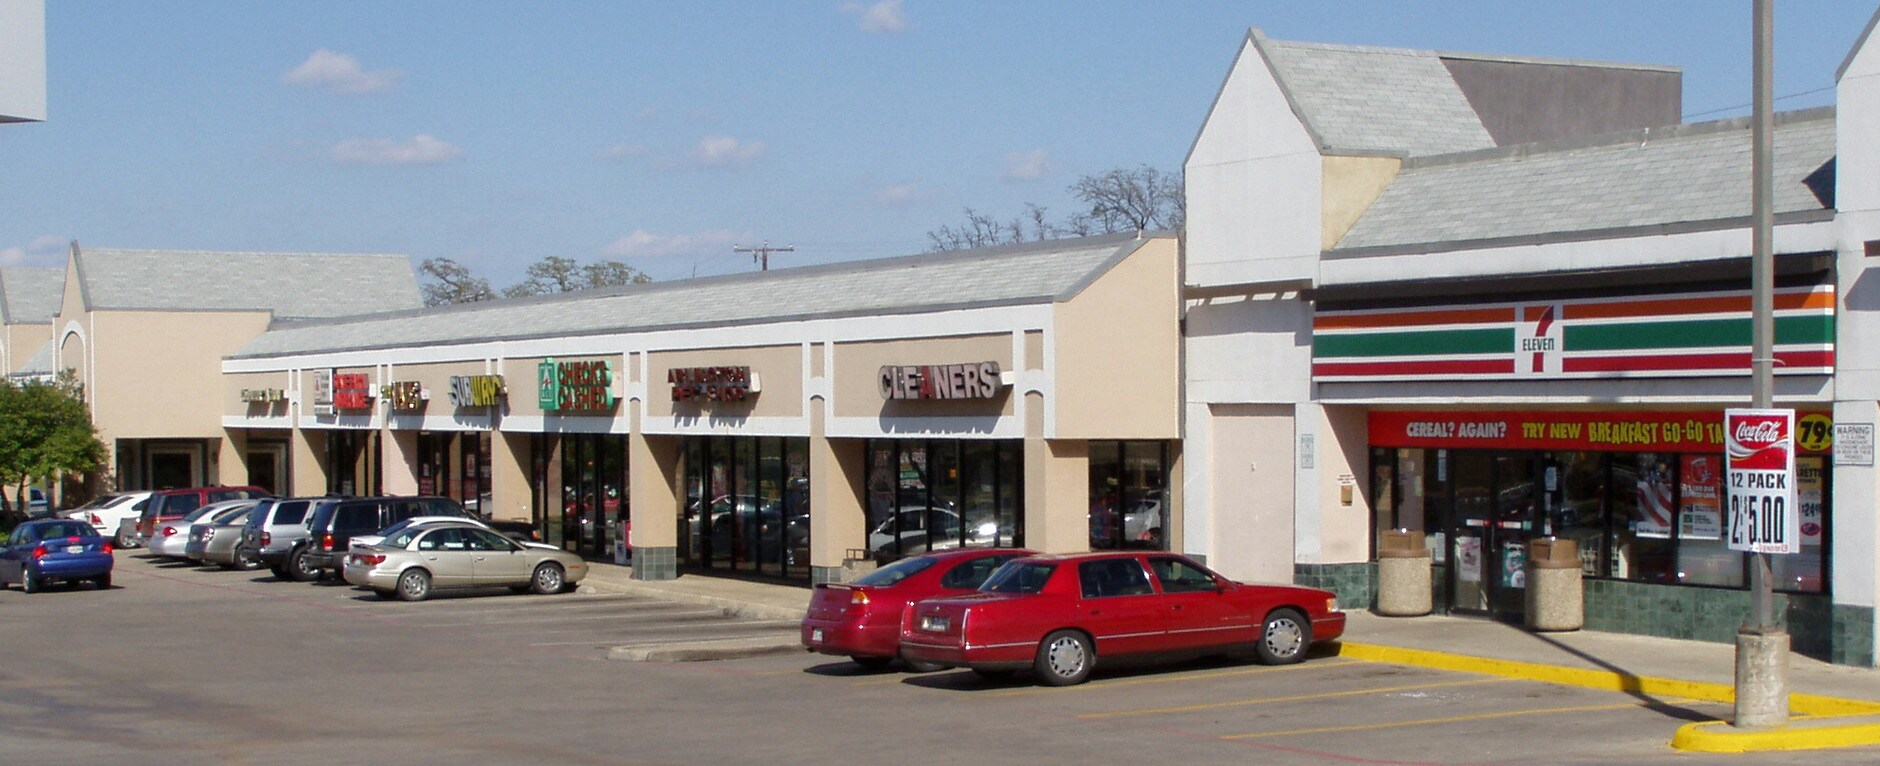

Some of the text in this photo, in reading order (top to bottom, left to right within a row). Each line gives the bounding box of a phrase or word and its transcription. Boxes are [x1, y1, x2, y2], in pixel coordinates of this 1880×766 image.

[1532, 305, 1554, 372] 7
[558, 361, 606, 386] CHECKS
[878, 362, 1000, 400] CLEANERS
[448, 375, 502, 407] SUBWAY
[558, 386, 607, 410] CASHED
[1406, 421, 1456, 438] CEREAL?
[1458, 421, 1507, 438] AGAIN?
[1522, 422, 1546, 439] TRY
[1550, 422, 1582, 439] NEW
[1588, 421, 1658, 445] BREAKFAST
[1663, 419, 1704, 443] GO-GO
[1731, 472, 1786, 489] 12 PACK
[1732, 494, 1739, 544] 2
